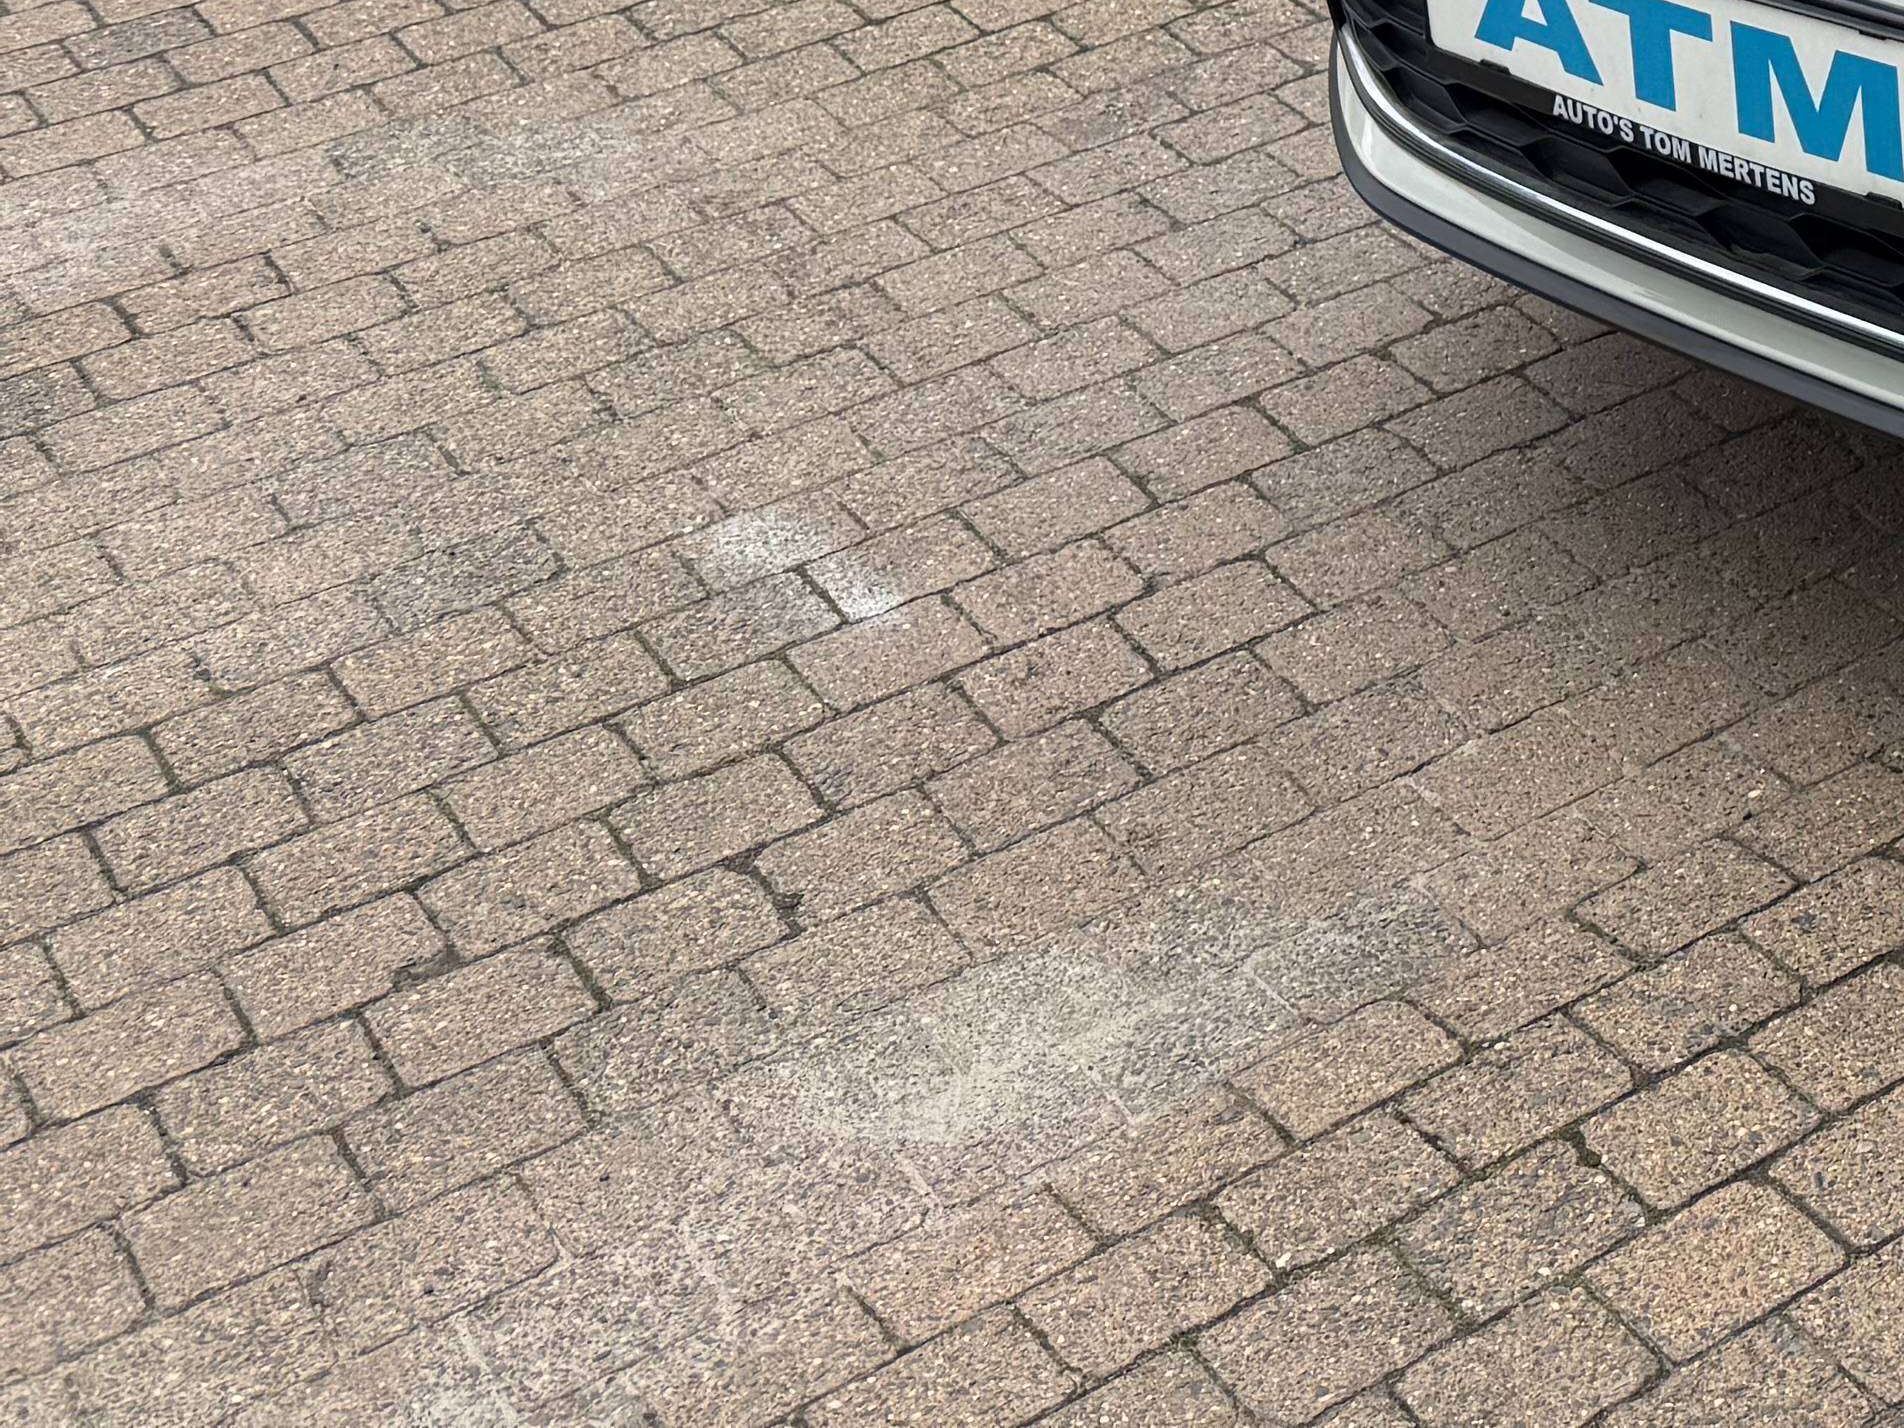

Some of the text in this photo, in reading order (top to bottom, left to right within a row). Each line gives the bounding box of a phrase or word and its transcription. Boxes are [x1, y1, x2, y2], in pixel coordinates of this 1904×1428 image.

[1552, 95, 1816, 206] AUTO'S TOM MERTENS
